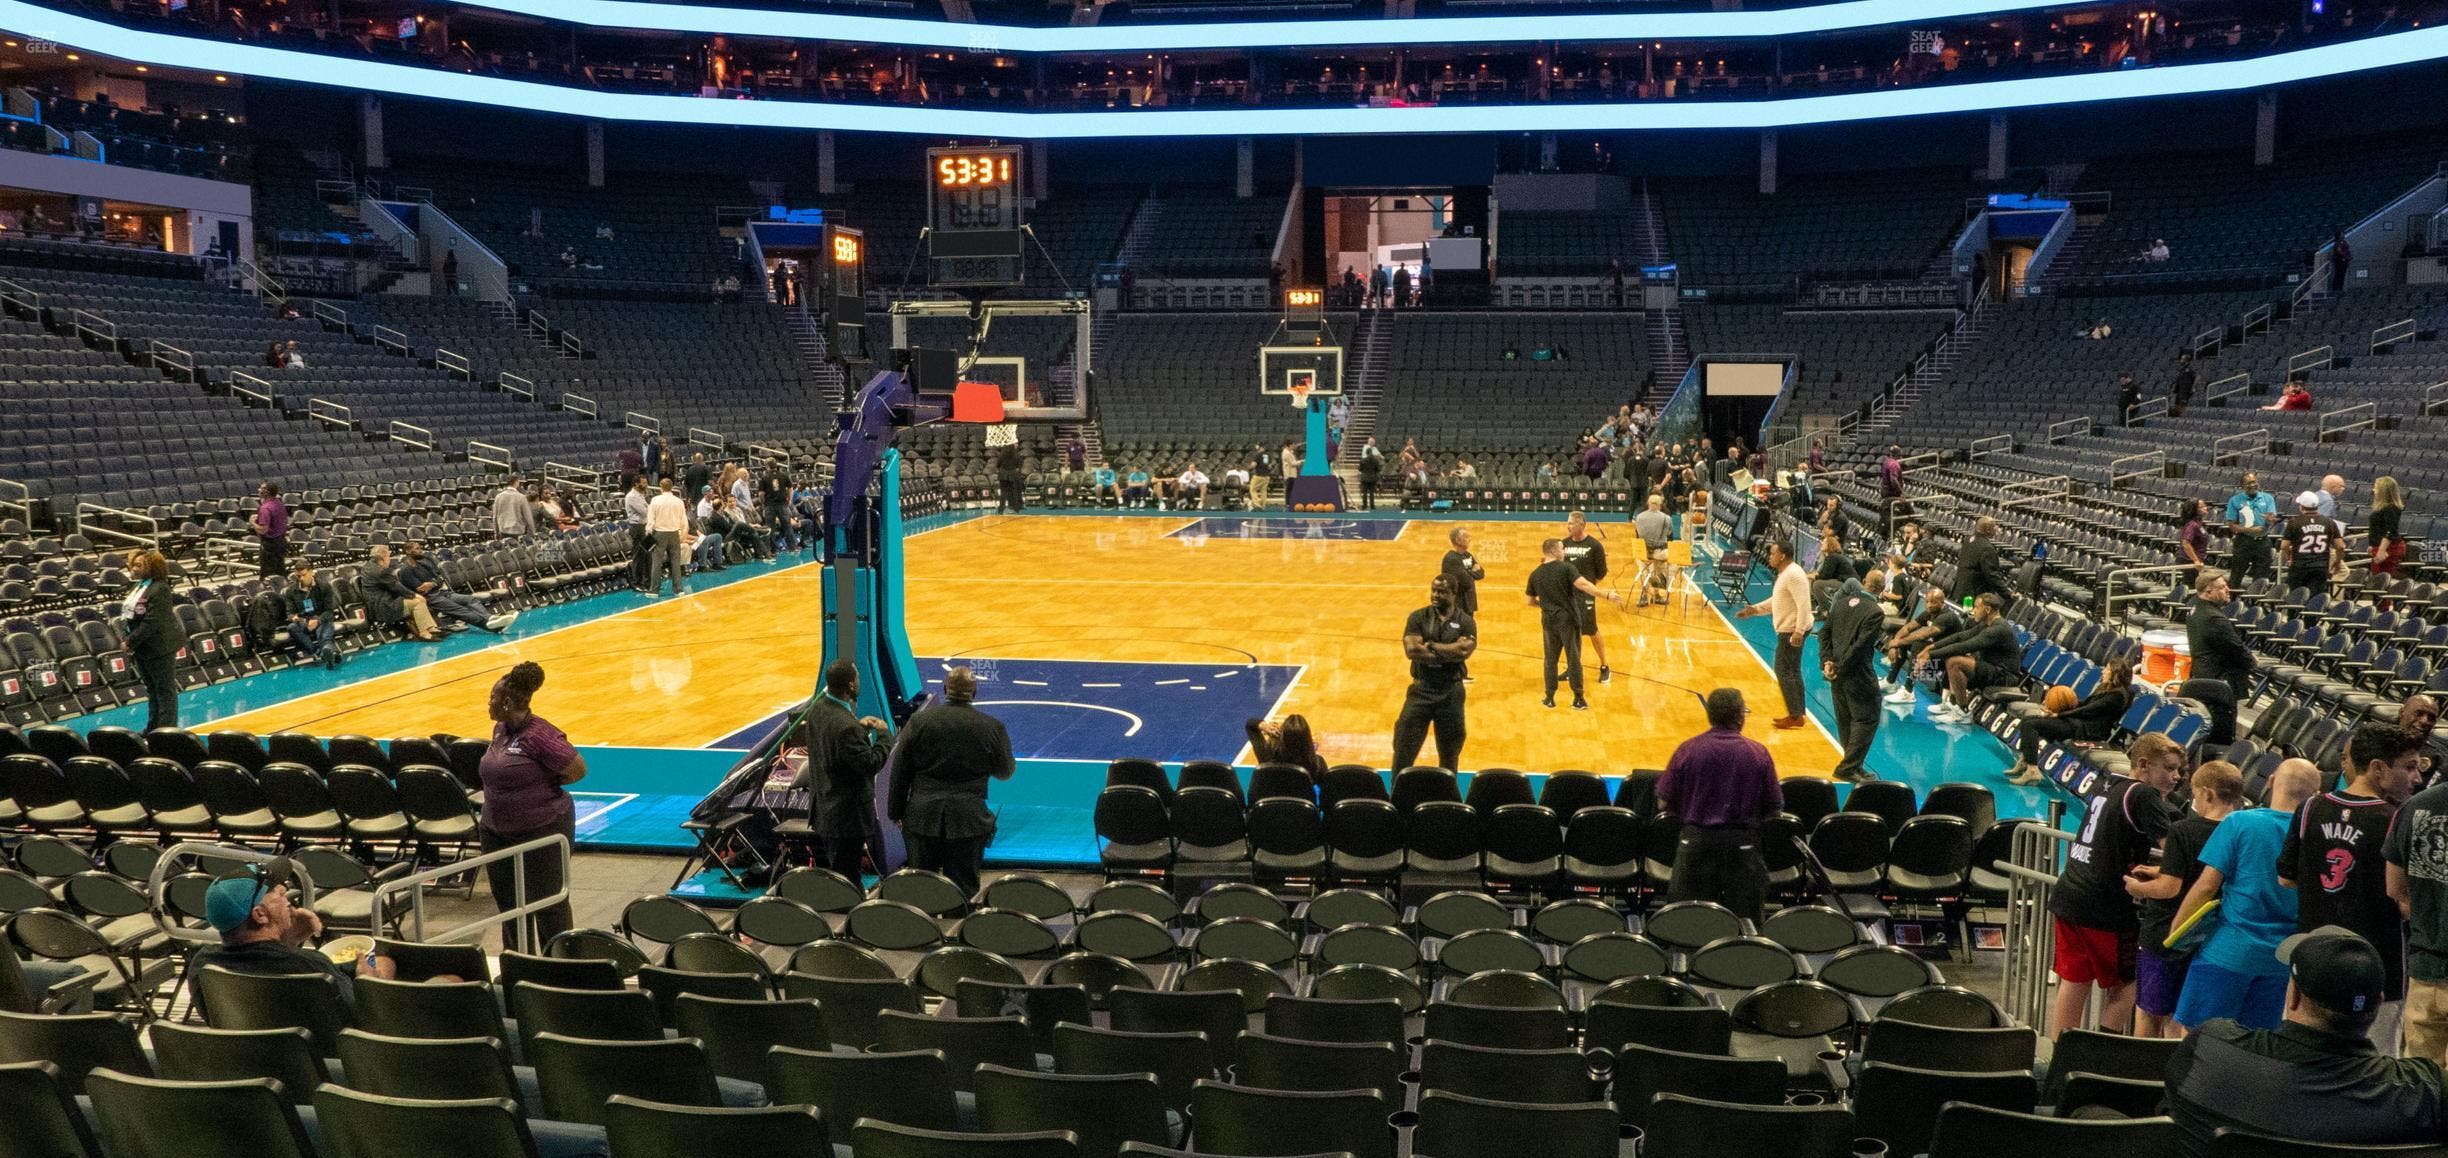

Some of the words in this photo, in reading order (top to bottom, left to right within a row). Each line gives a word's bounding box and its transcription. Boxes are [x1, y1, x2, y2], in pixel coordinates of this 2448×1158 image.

[940, 156, 1009, 186] 53:31
[2298, 534, 2328, 554] 25
[2044, 748, 2064, 771] G
[2078, 771, 2097, 794] G
[2082, 795, 2107, 844] 3
[2321, 822, 2363, 845] WADE
[2070, 842, 2092, 864] WADE
[2319, 847, 2356, 893] 3
[1936, 931, 1947, 944] 2
